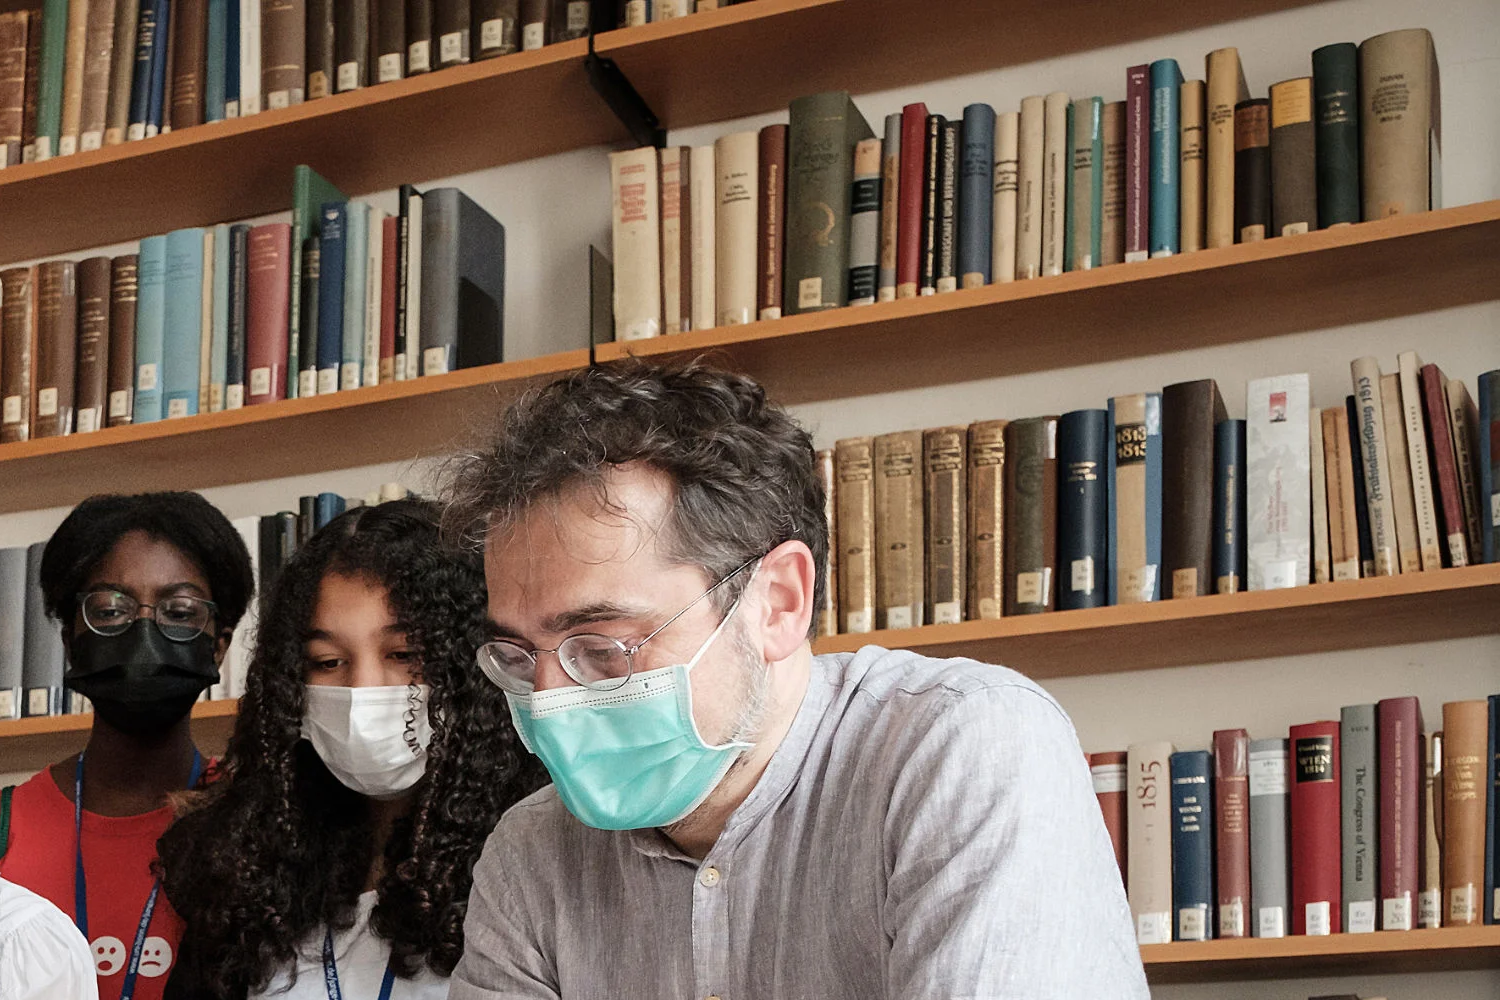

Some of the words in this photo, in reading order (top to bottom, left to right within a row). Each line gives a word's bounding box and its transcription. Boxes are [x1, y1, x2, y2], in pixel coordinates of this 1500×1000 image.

[1361, 376, 1372, 403] 1813
[1116, 426, 1147, 444] 1813
[1117, 441, 1147, 459] 1815
[1299, 754, 1331, 766] WIEN
[1137, 760, 1162, 810] 1815
[1355, 766, 1366, 785] The
[1354, 788, 1366, 832] Congress
[1356, 834, 1366, 845] of
[1355, 848, 1366, 882] Vienna
